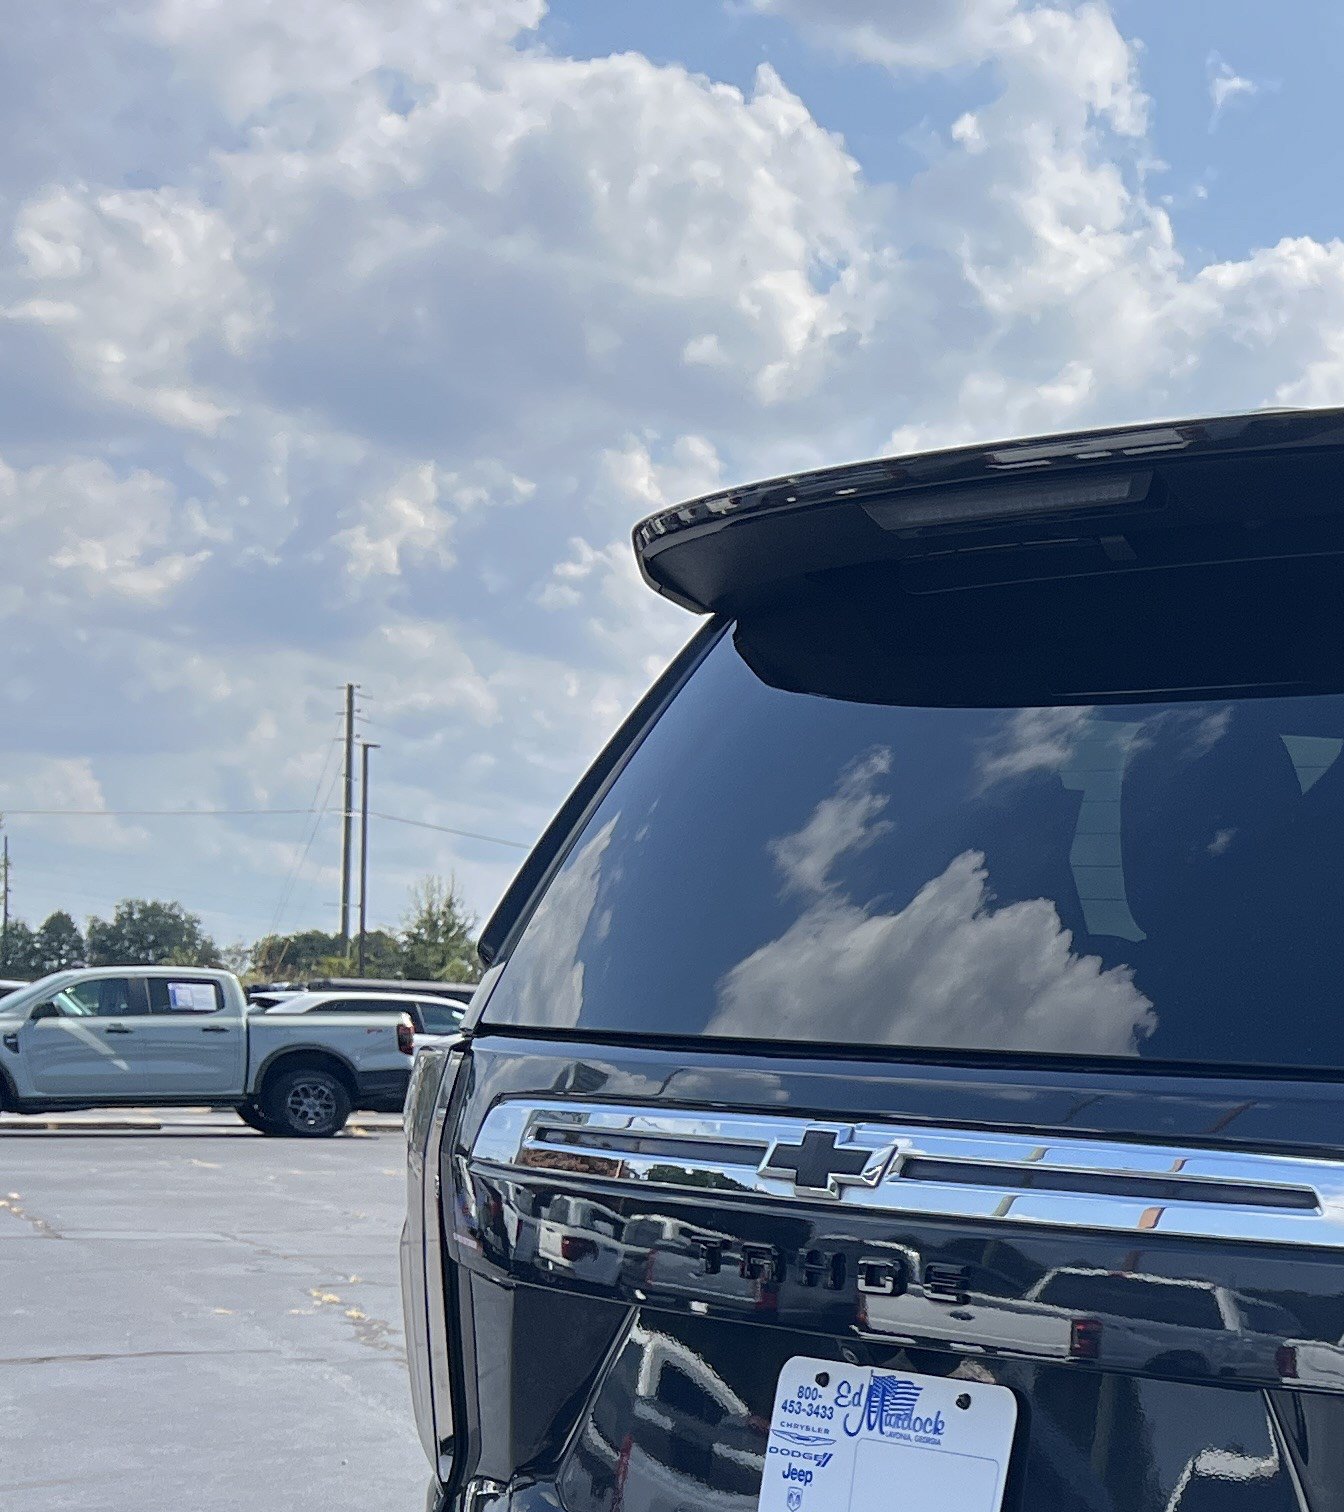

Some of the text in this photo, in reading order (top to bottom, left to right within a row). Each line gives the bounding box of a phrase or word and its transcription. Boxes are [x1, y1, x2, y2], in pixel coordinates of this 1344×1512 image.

[691, 1235, 972, 1306] TAHOE
[797, 1385, 823, 1401] 800-
[834, 1380, 864, 1408] Ed
[781, 1399, 834, 1420] 453-3433
[780, 1421, 830, 1434] CHRYSLER
[768, 1446, 826, 1463] DODGE
[782, 1462, 813, 1487] Jeep
